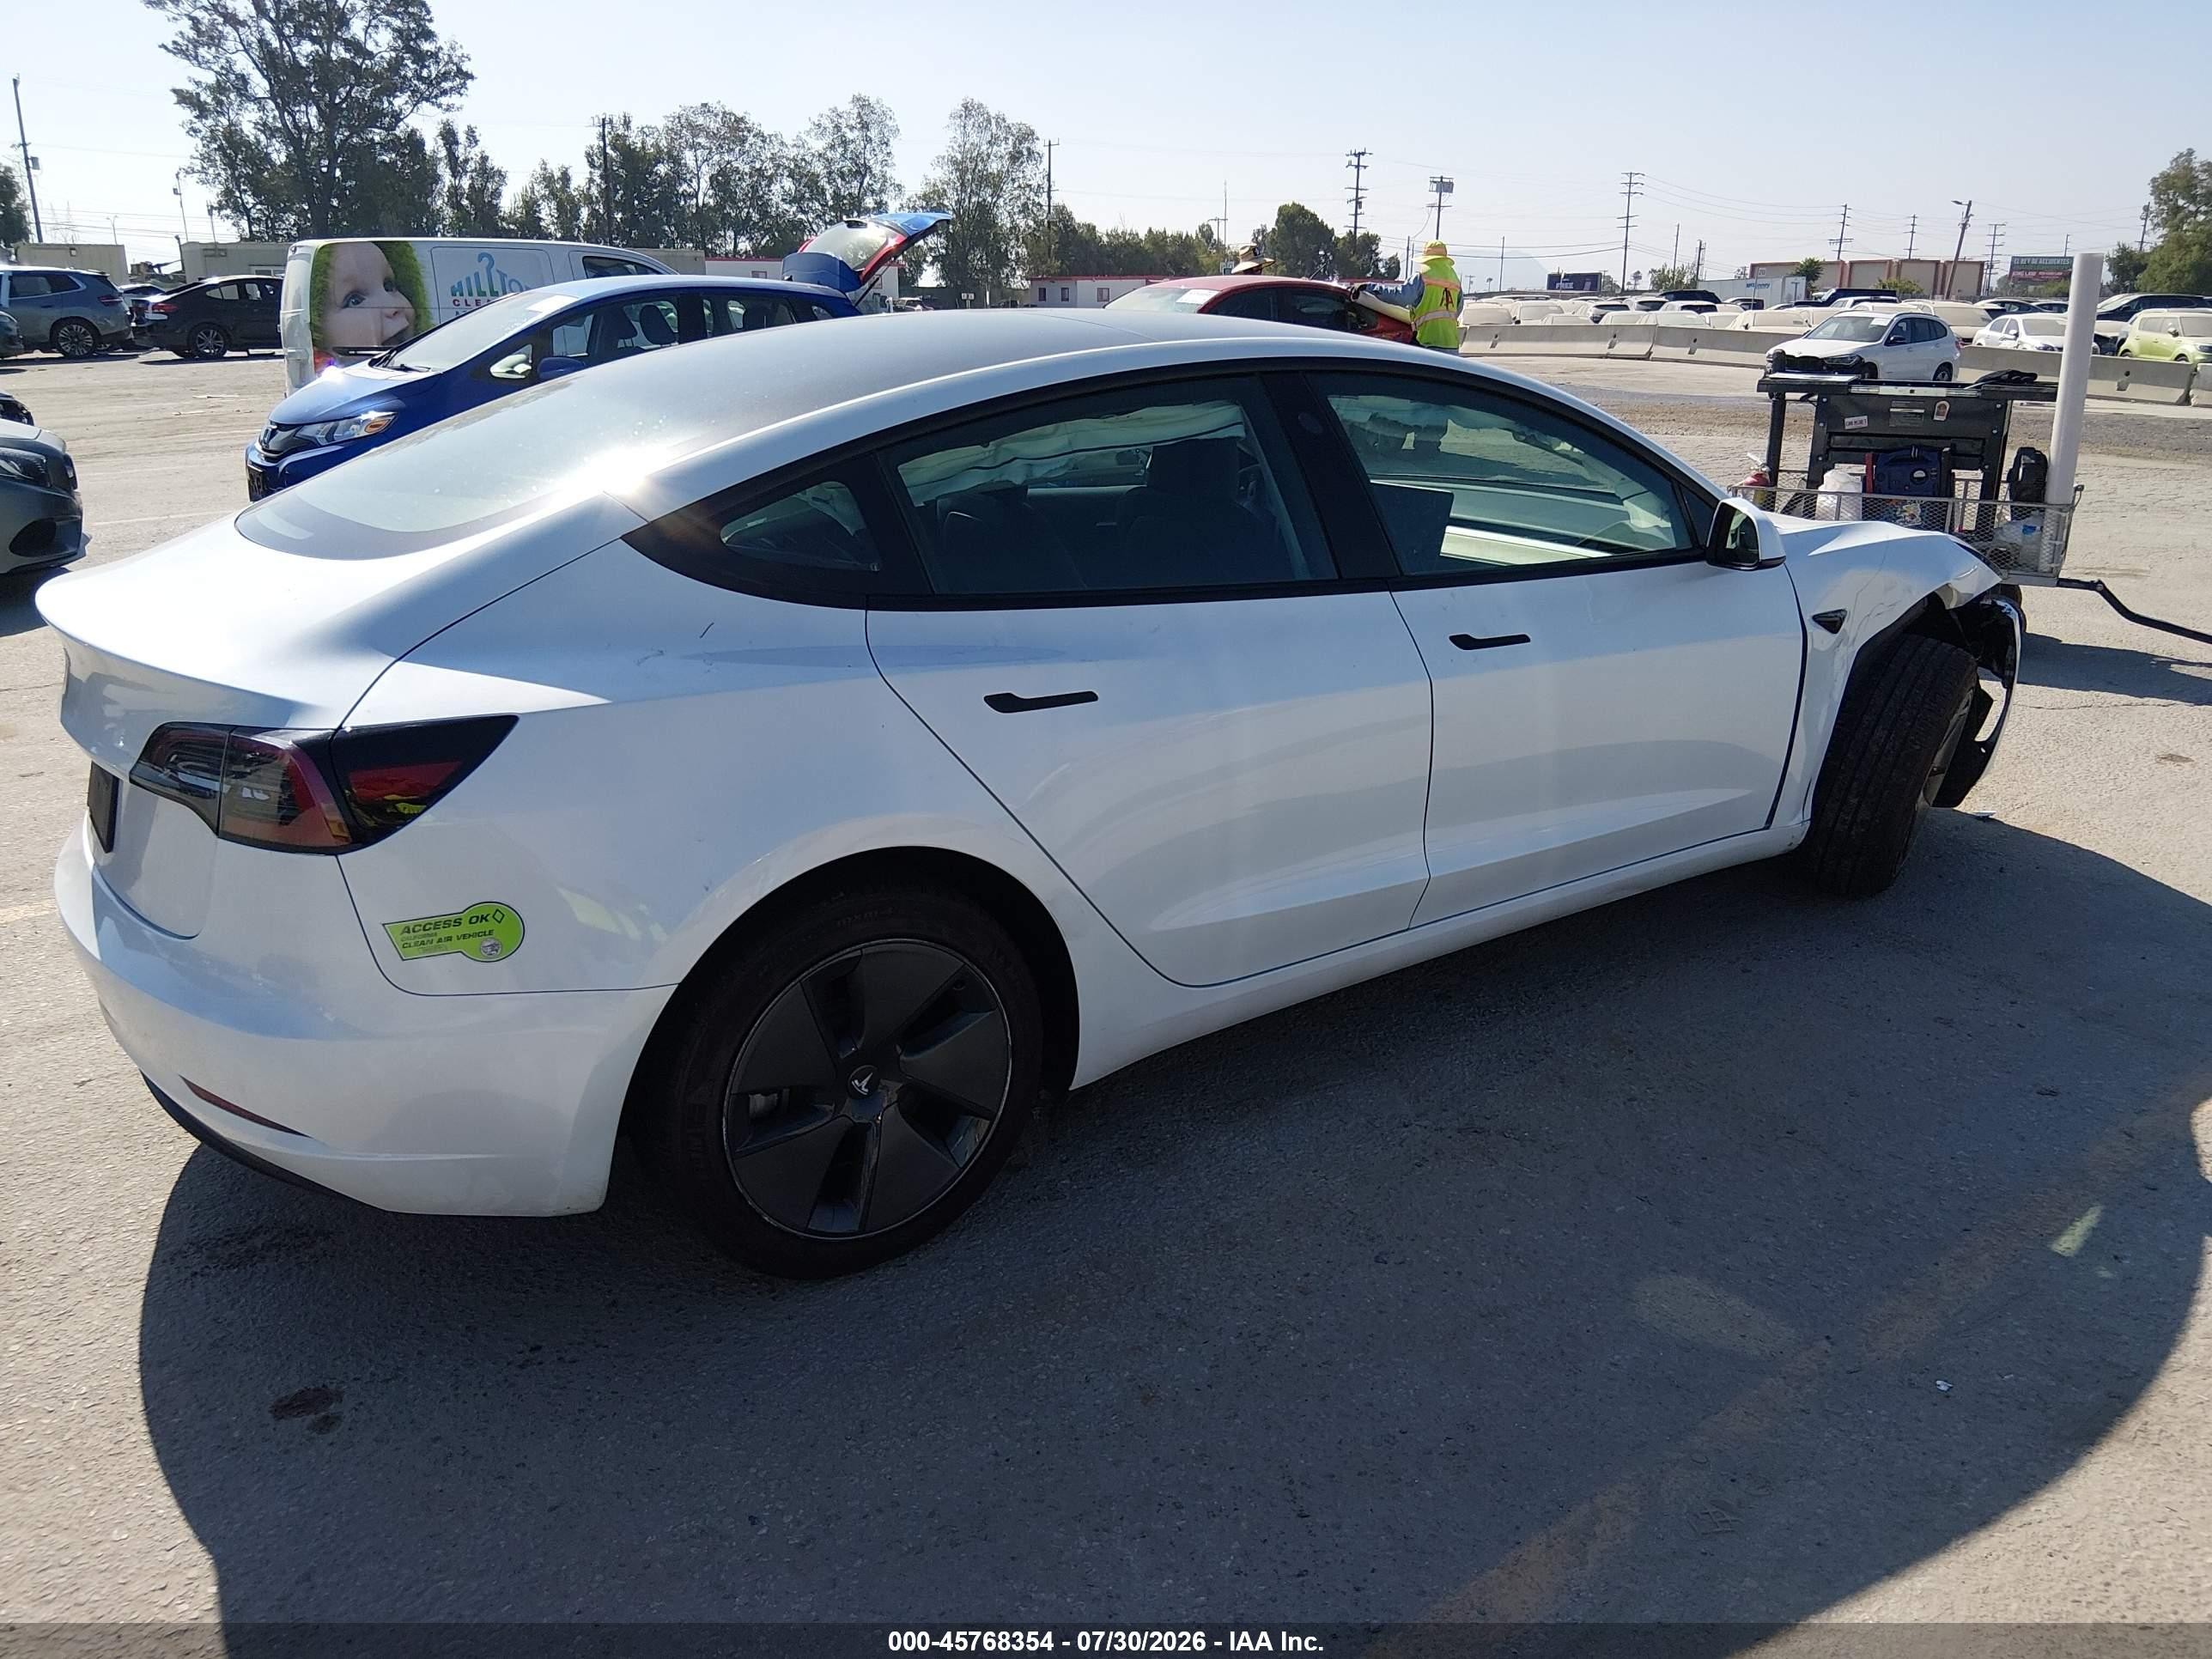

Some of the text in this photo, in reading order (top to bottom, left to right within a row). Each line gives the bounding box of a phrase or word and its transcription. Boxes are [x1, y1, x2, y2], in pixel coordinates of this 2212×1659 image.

[450, 252, 532, 297] HILLTO
[400, 913, 490, 935] ACCESS OK
[402, 939, 434, 949] CLEAN
[436, 935, 453, 944] AIR
[456, 929, 494, 940] VEHICLE
